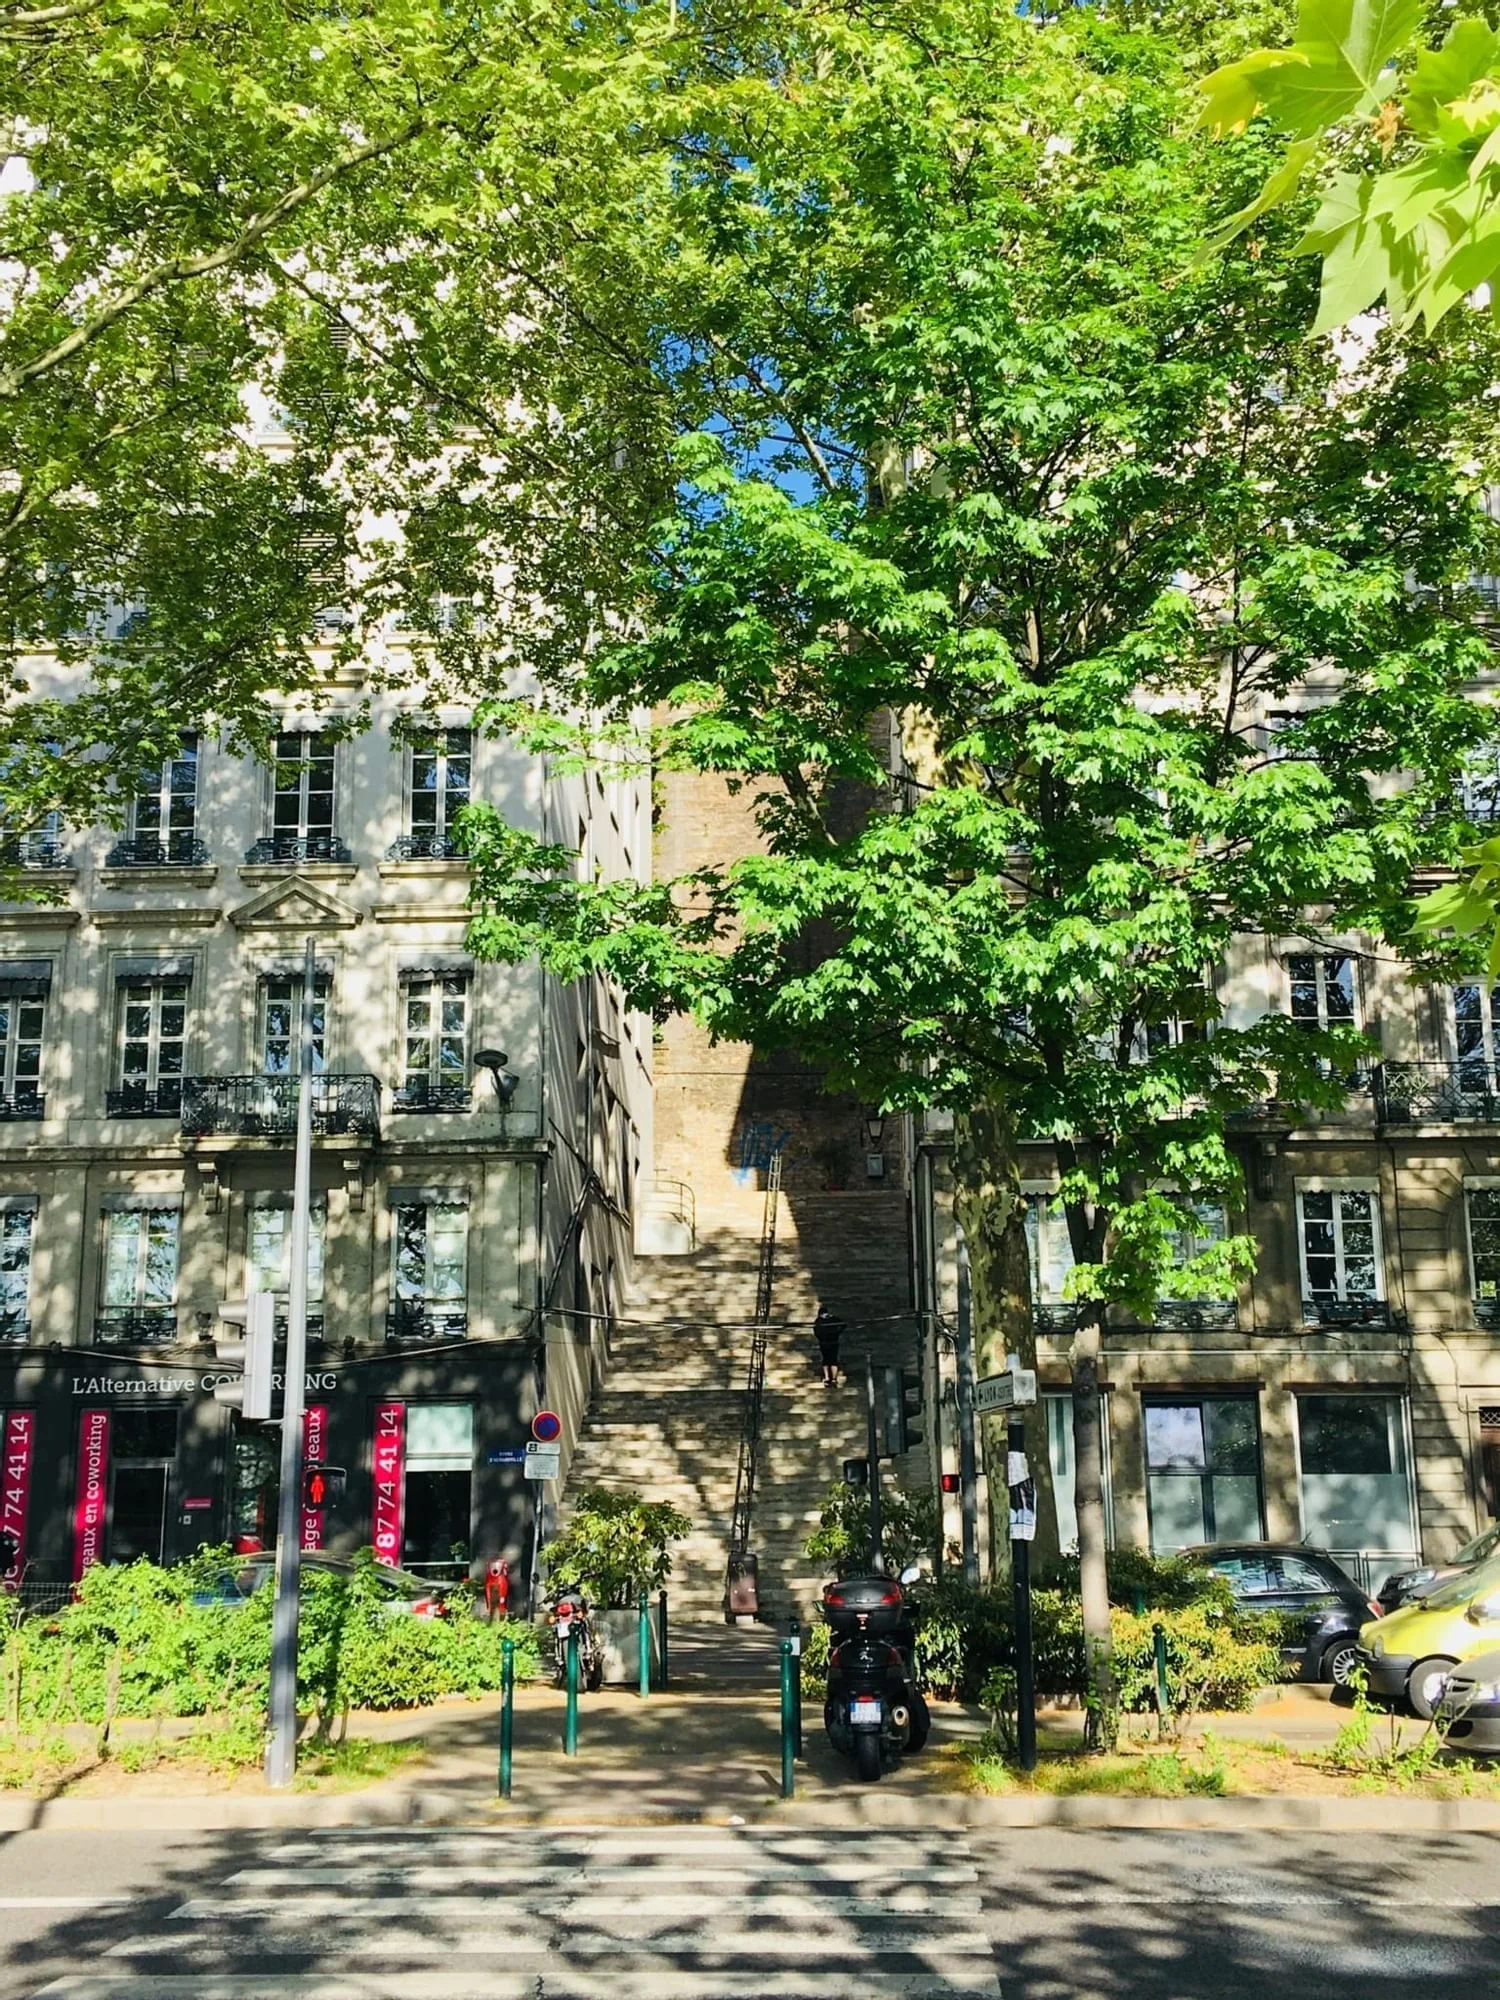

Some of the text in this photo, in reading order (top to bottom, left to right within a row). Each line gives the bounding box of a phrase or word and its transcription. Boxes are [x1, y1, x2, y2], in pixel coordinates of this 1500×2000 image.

[72, 1375, 195, 1394] L'Alternative
[10, 1416, 29, 1444] 14
[380, 1409, 398, 1437] 14
[8, 1451, 27, 1480] 41
[86, 1414, 106, 1500] coworking
[378, 1444, 397, 1473] 41
[4, 1488, 24, 1518] 74
[377, 1480, 396, 1511] 74
[84, 1503, 98, 1524] en
[376, 1518, 396, 1548] 87
